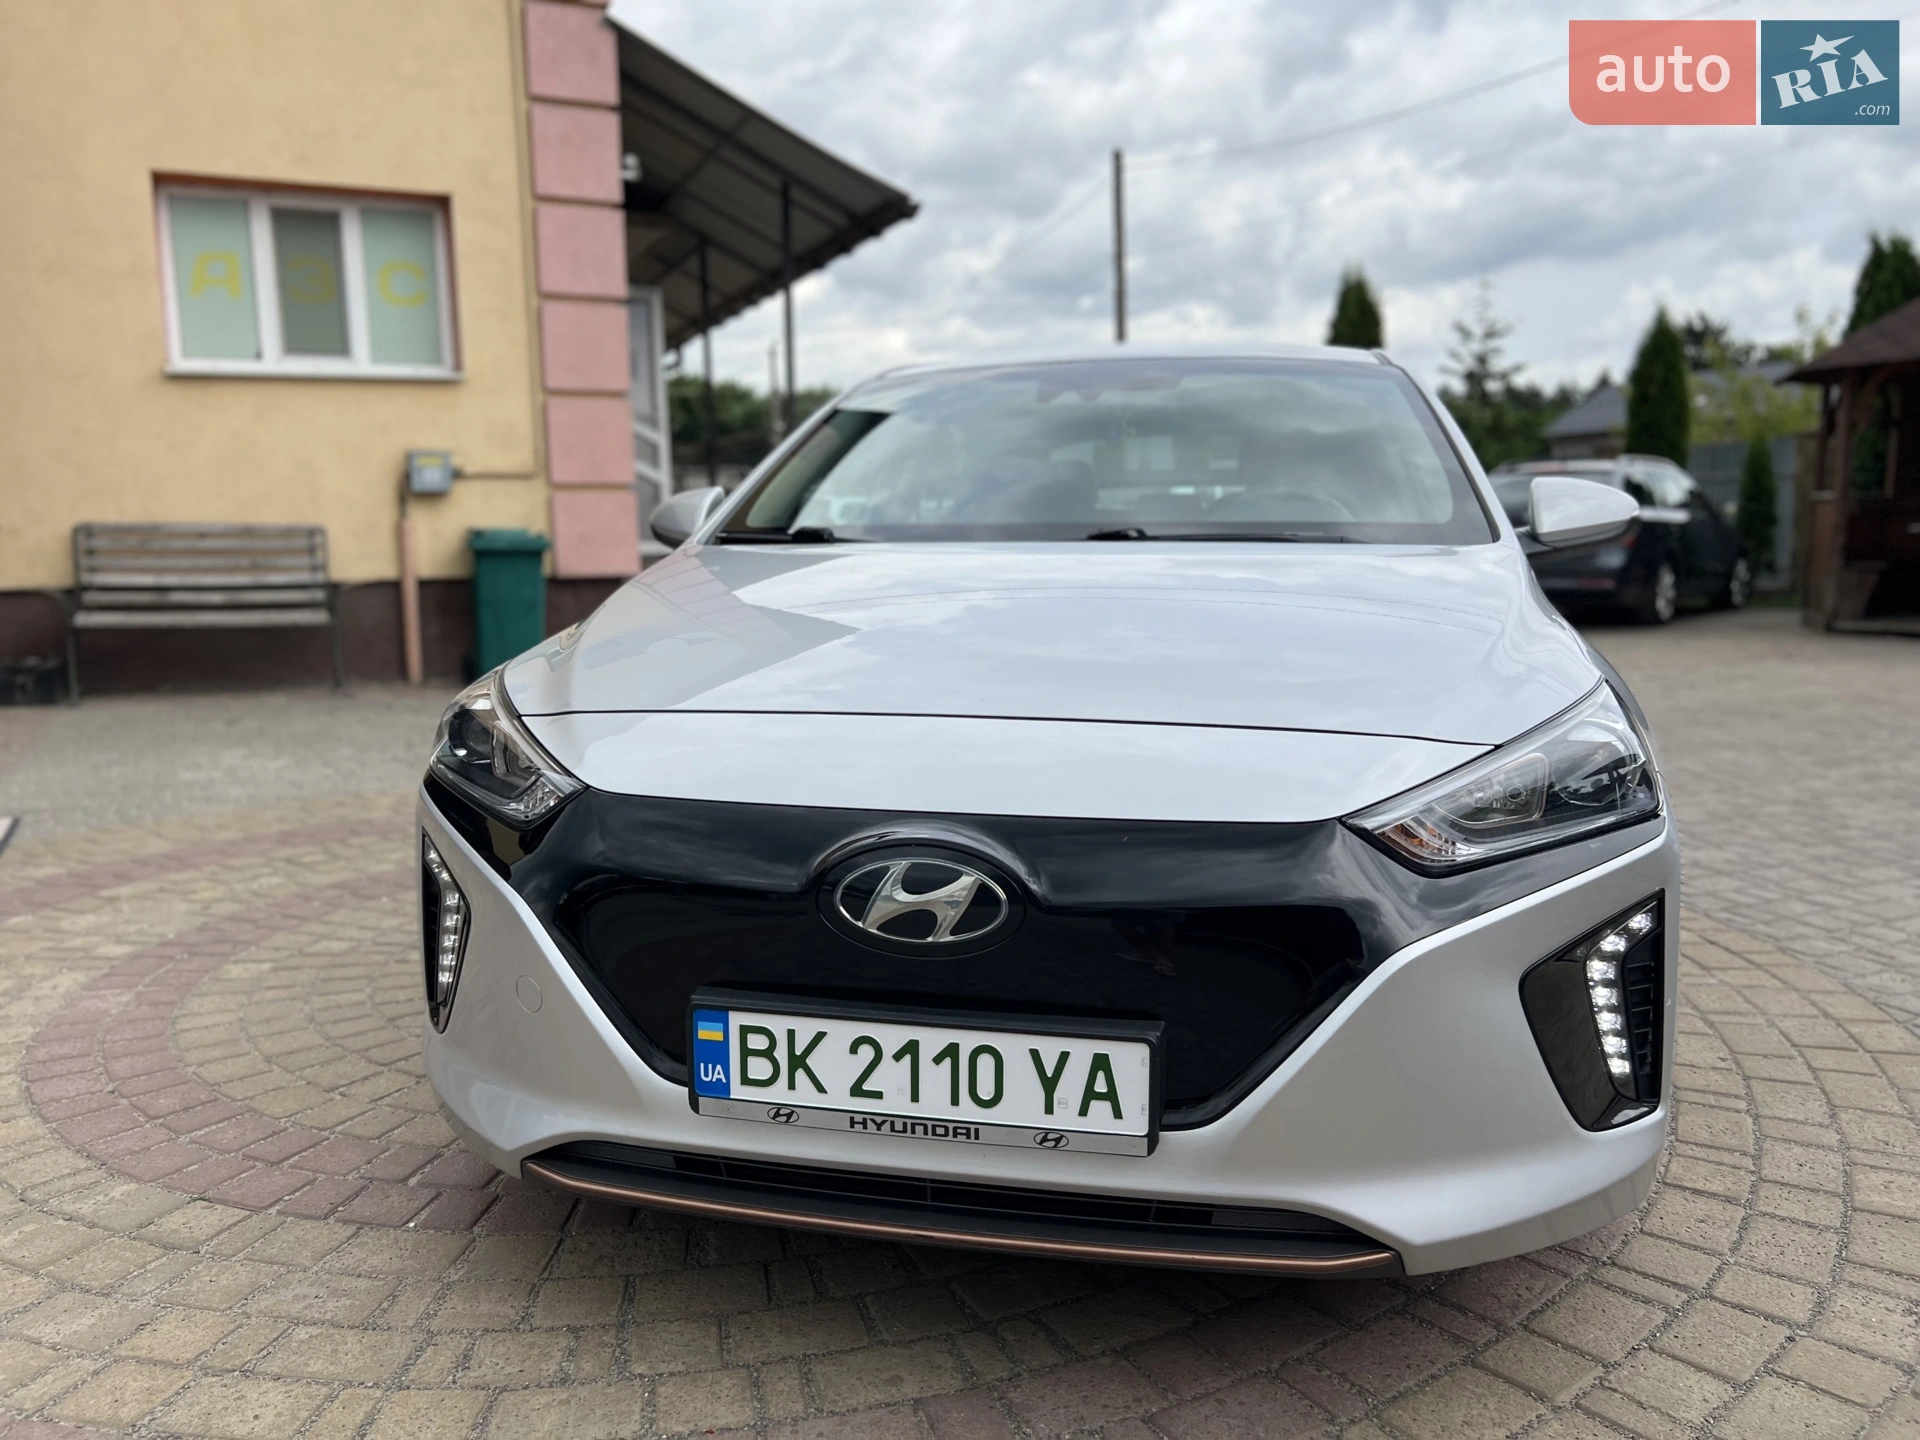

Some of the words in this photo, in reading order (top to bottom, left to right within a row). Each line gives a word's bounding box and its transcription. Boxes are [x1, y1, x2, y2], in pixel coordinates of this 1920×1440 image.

[700, 1063, 726, 1083] UA
[739, 1024, 828, 1094] BK
[848, 1035, 1004, 1109] 2110
[1028, 1048, 1124, 1120] YA
[849, 1116, 980, 1141] HYUNDAI
